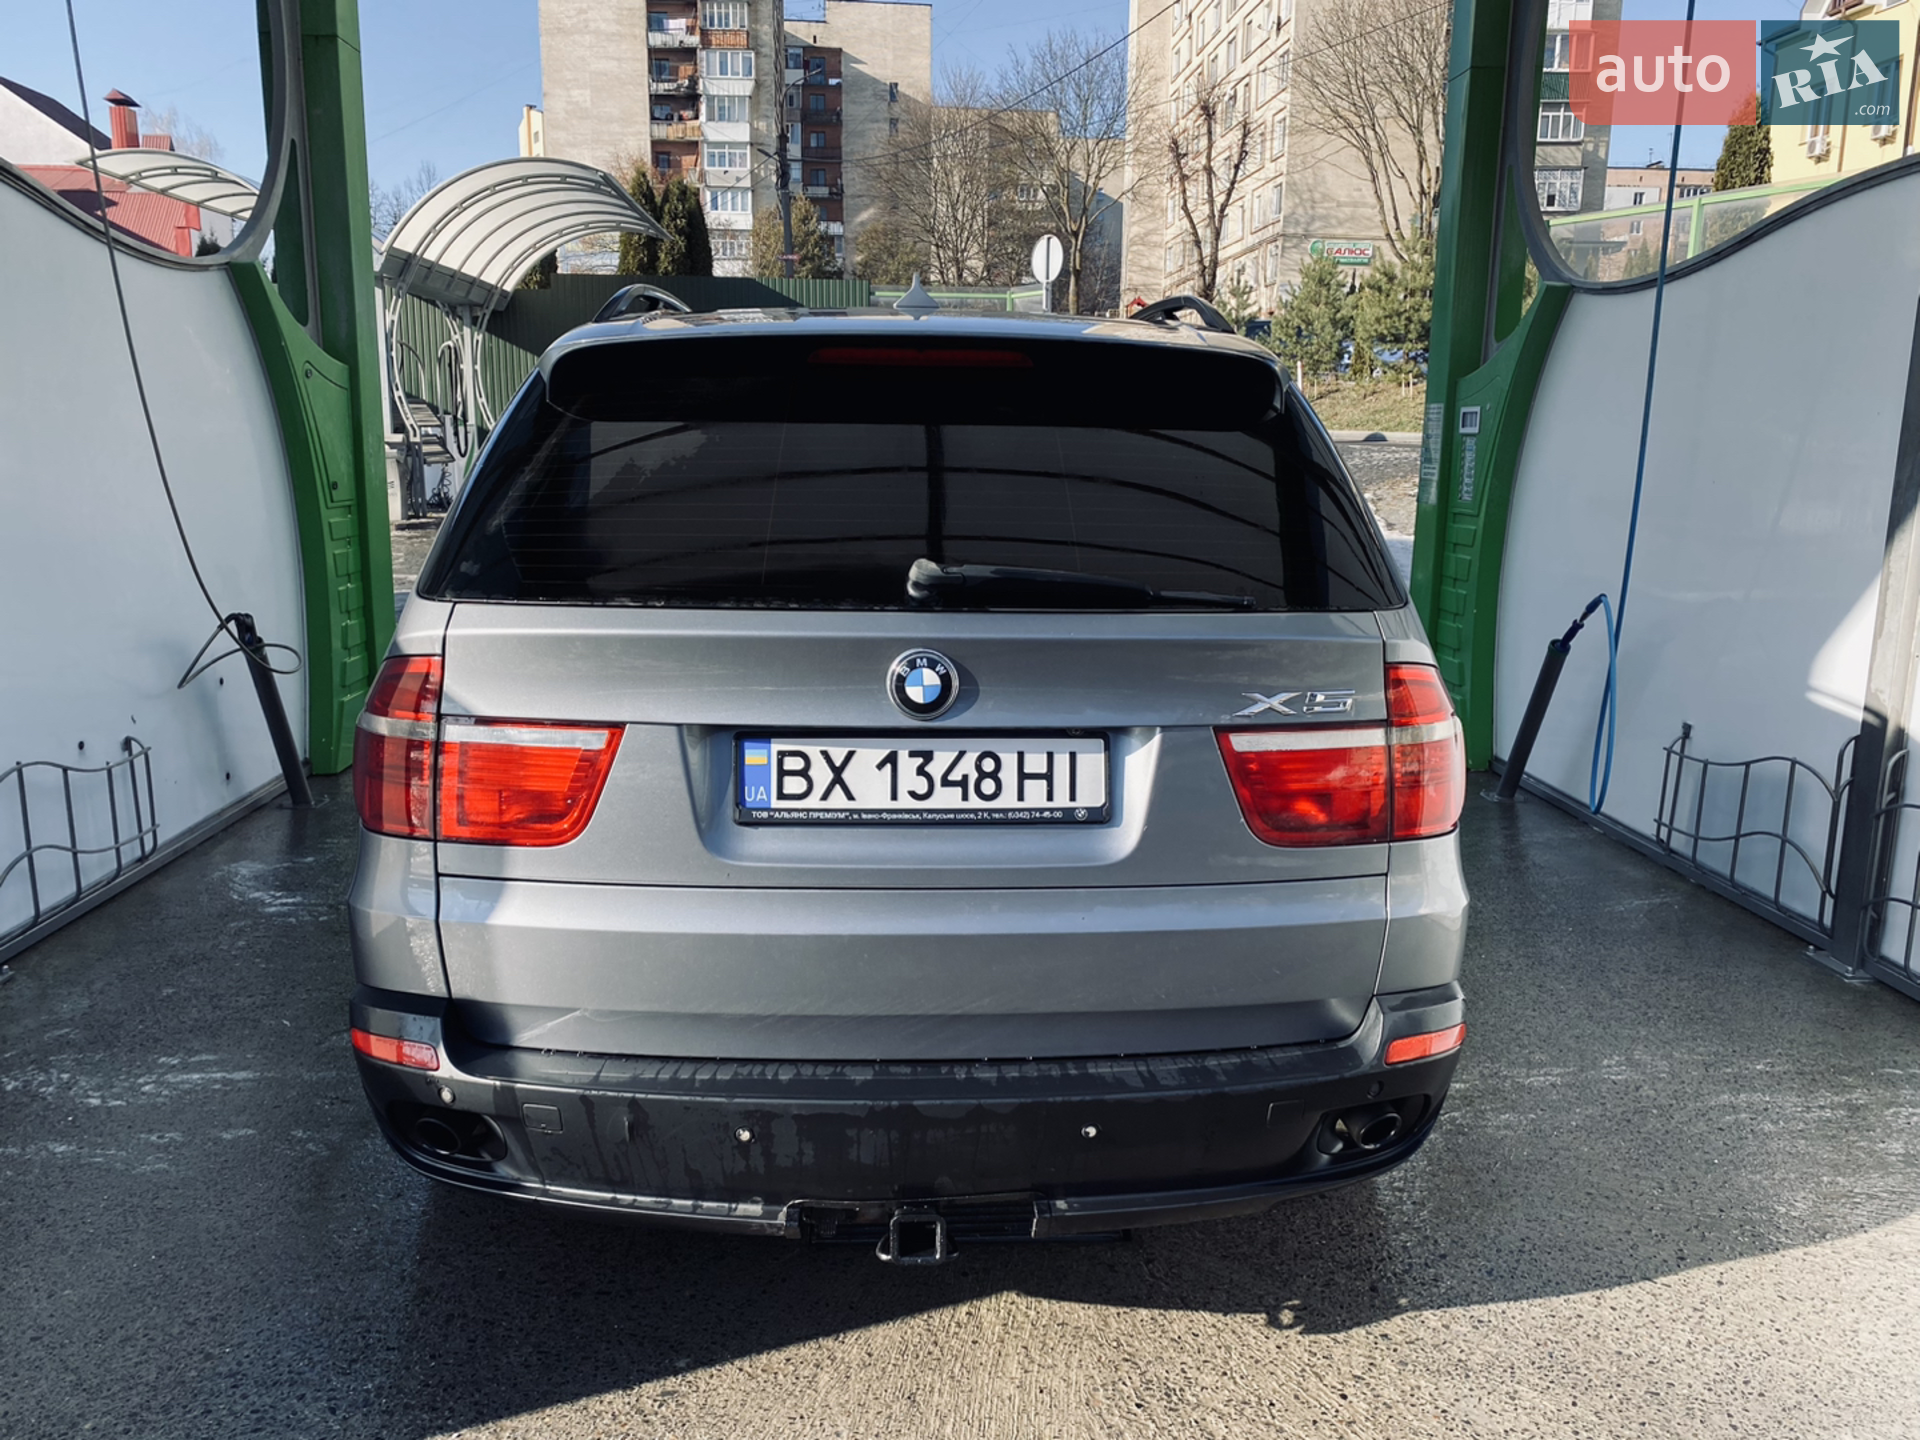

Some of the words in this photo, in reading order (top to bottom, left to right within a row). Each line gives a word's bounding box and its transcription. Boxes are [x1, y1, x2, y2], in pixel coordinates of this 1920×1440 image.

[899, 657, 947, 677] BMW
[1232, 689, 1356, 716] X5
[875, 750, 1002, 802] 1348
[744, 786, 769, 802] UA
[752, 811, 769, 819] ТОВ
